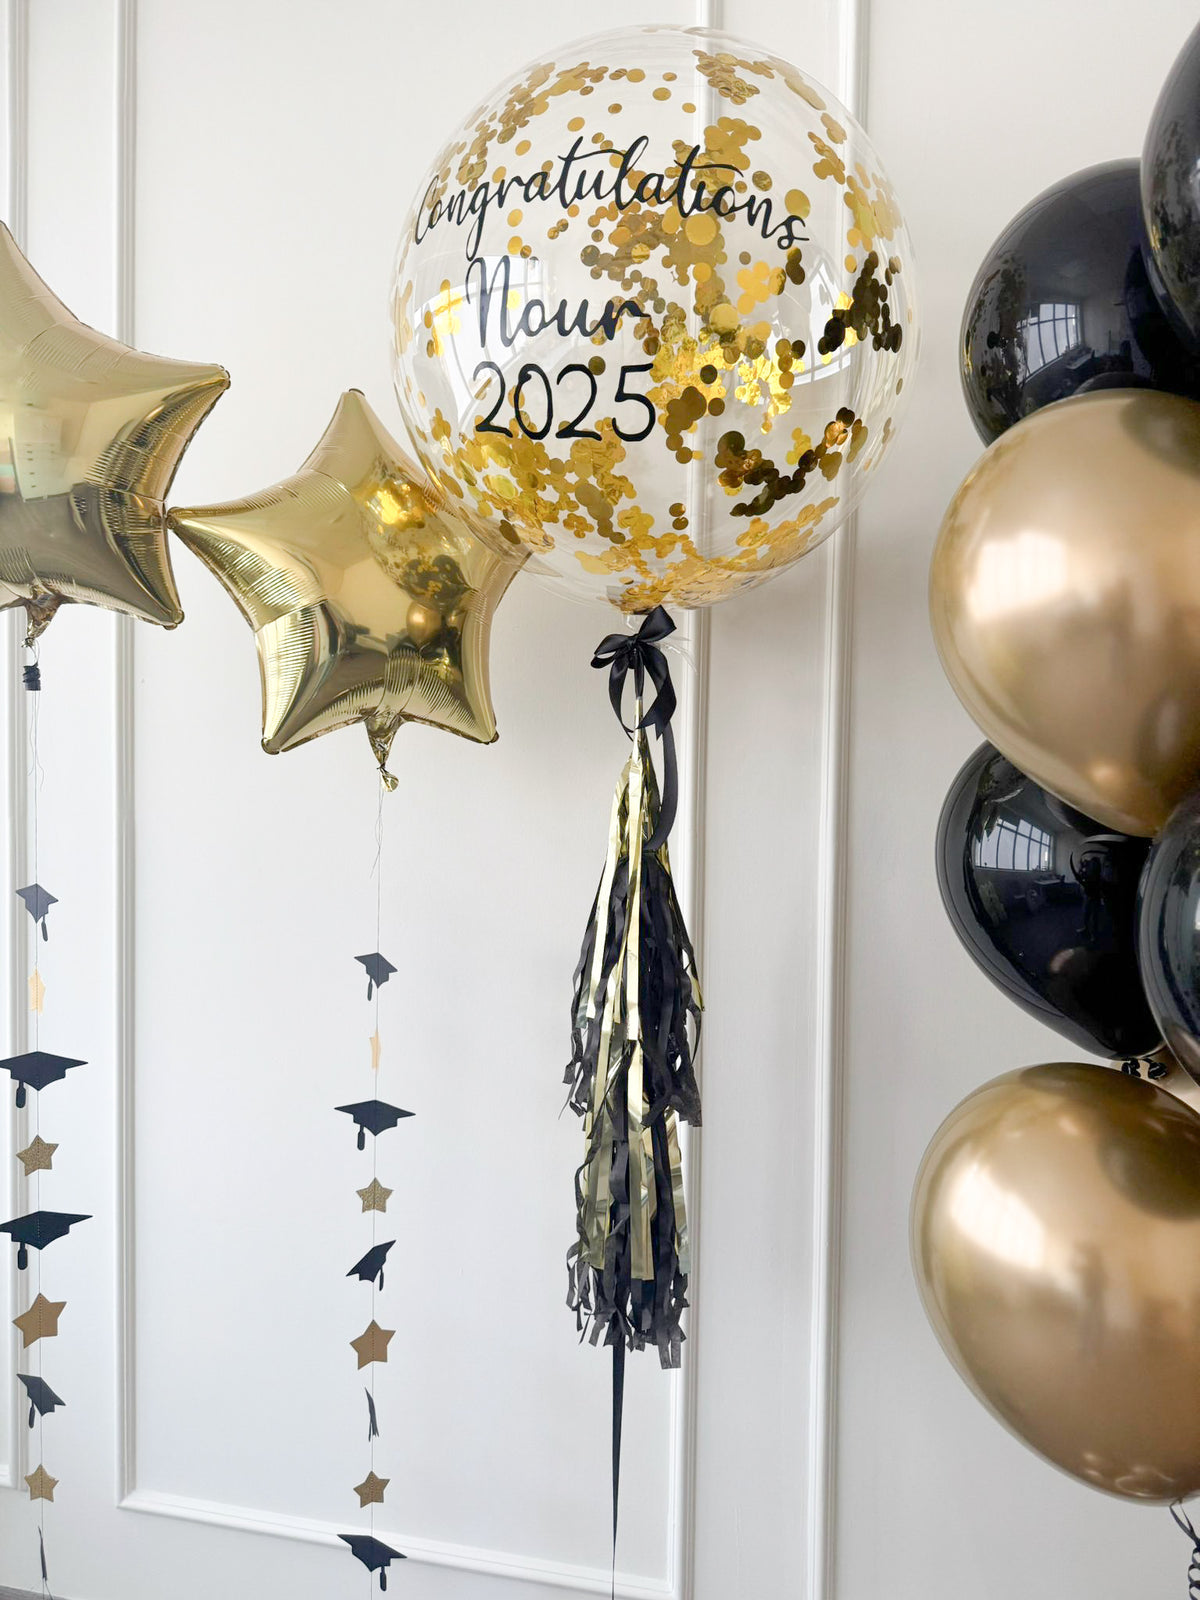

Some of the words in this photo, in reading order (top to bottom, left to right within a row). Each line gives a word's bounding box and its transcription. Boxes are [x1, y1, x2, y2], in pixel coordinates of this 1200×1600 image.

[414, 135, 810, 261] Congratulations
[465, 255, 651, 348] Nour
[472, 361, 656, 442] 2025
